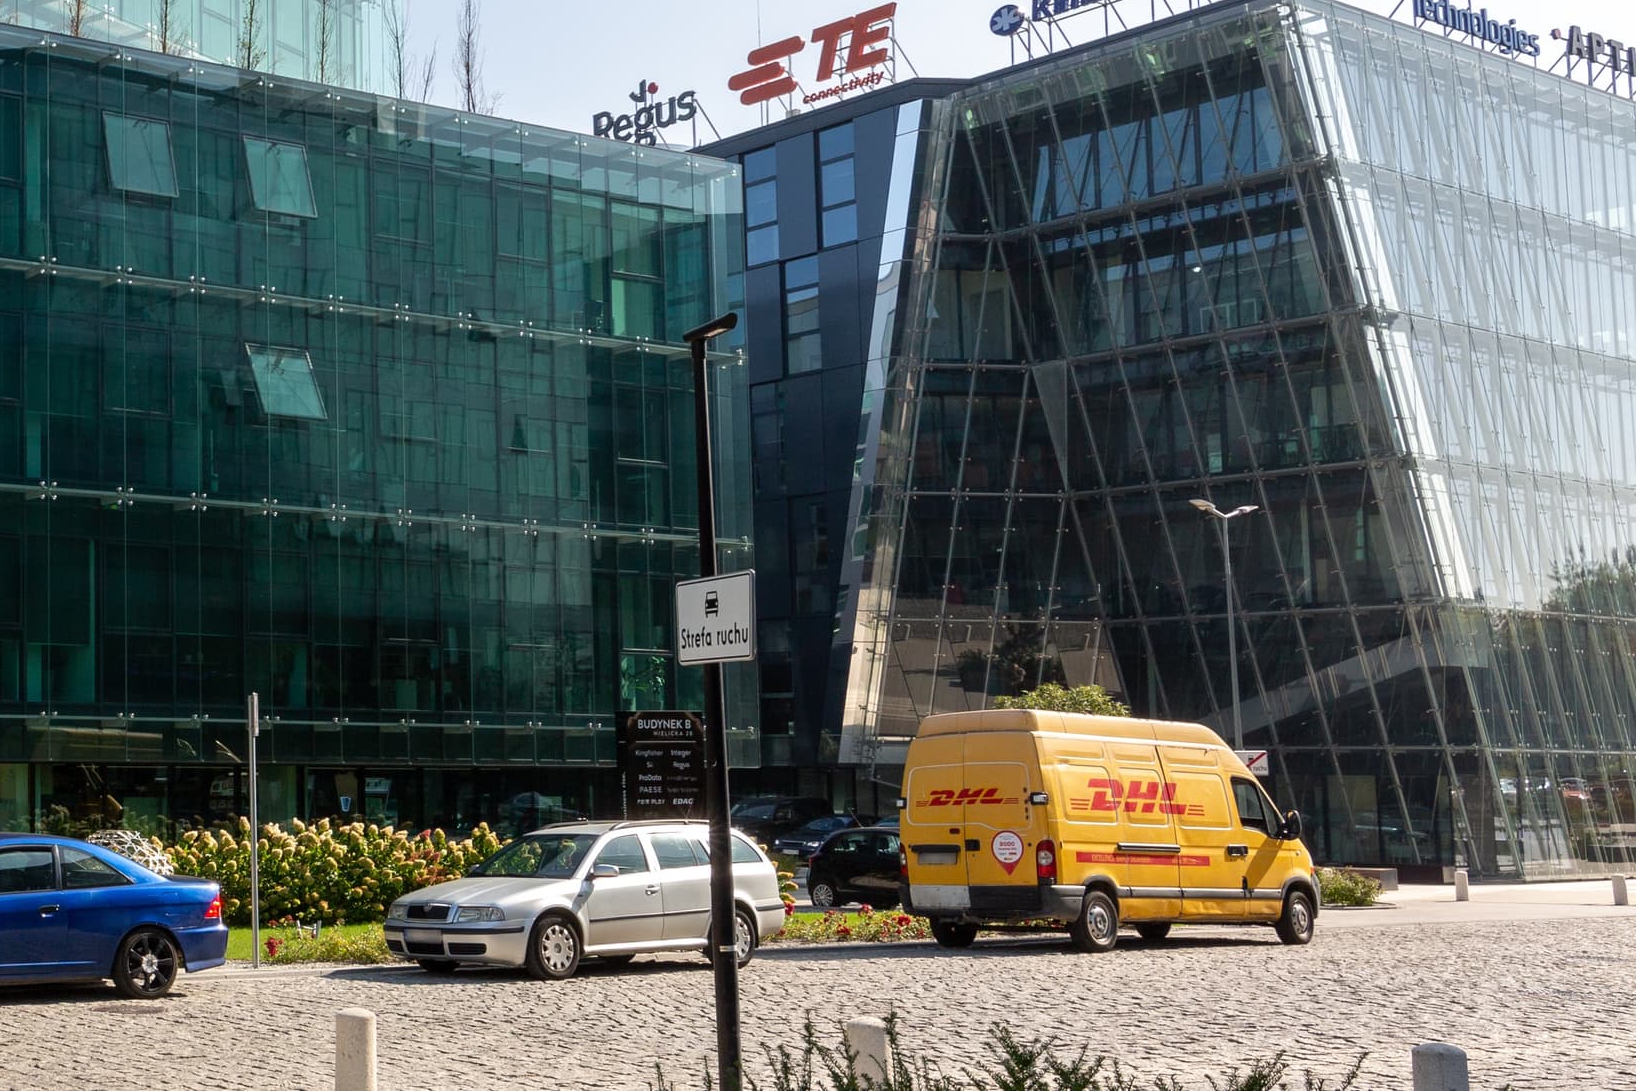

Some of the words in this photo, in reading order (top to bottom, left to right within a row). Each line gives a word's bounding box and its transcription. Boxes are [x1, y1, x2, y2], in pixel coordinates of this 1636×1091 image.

[810, 2, 897, 82] TE
[802, 71, 884, 104] connectivity
[592, 90, 697, 146] Regus
[681, 626, 712, 649] Strefa
[716, 622, 749, 646] ruchu
[637, 719, 683, 730] BUDYNEK
[684, 719, 692, 730] B
[928, 788, 1005, 807] DHL
[1087, 778, 1188, 815] DHL
